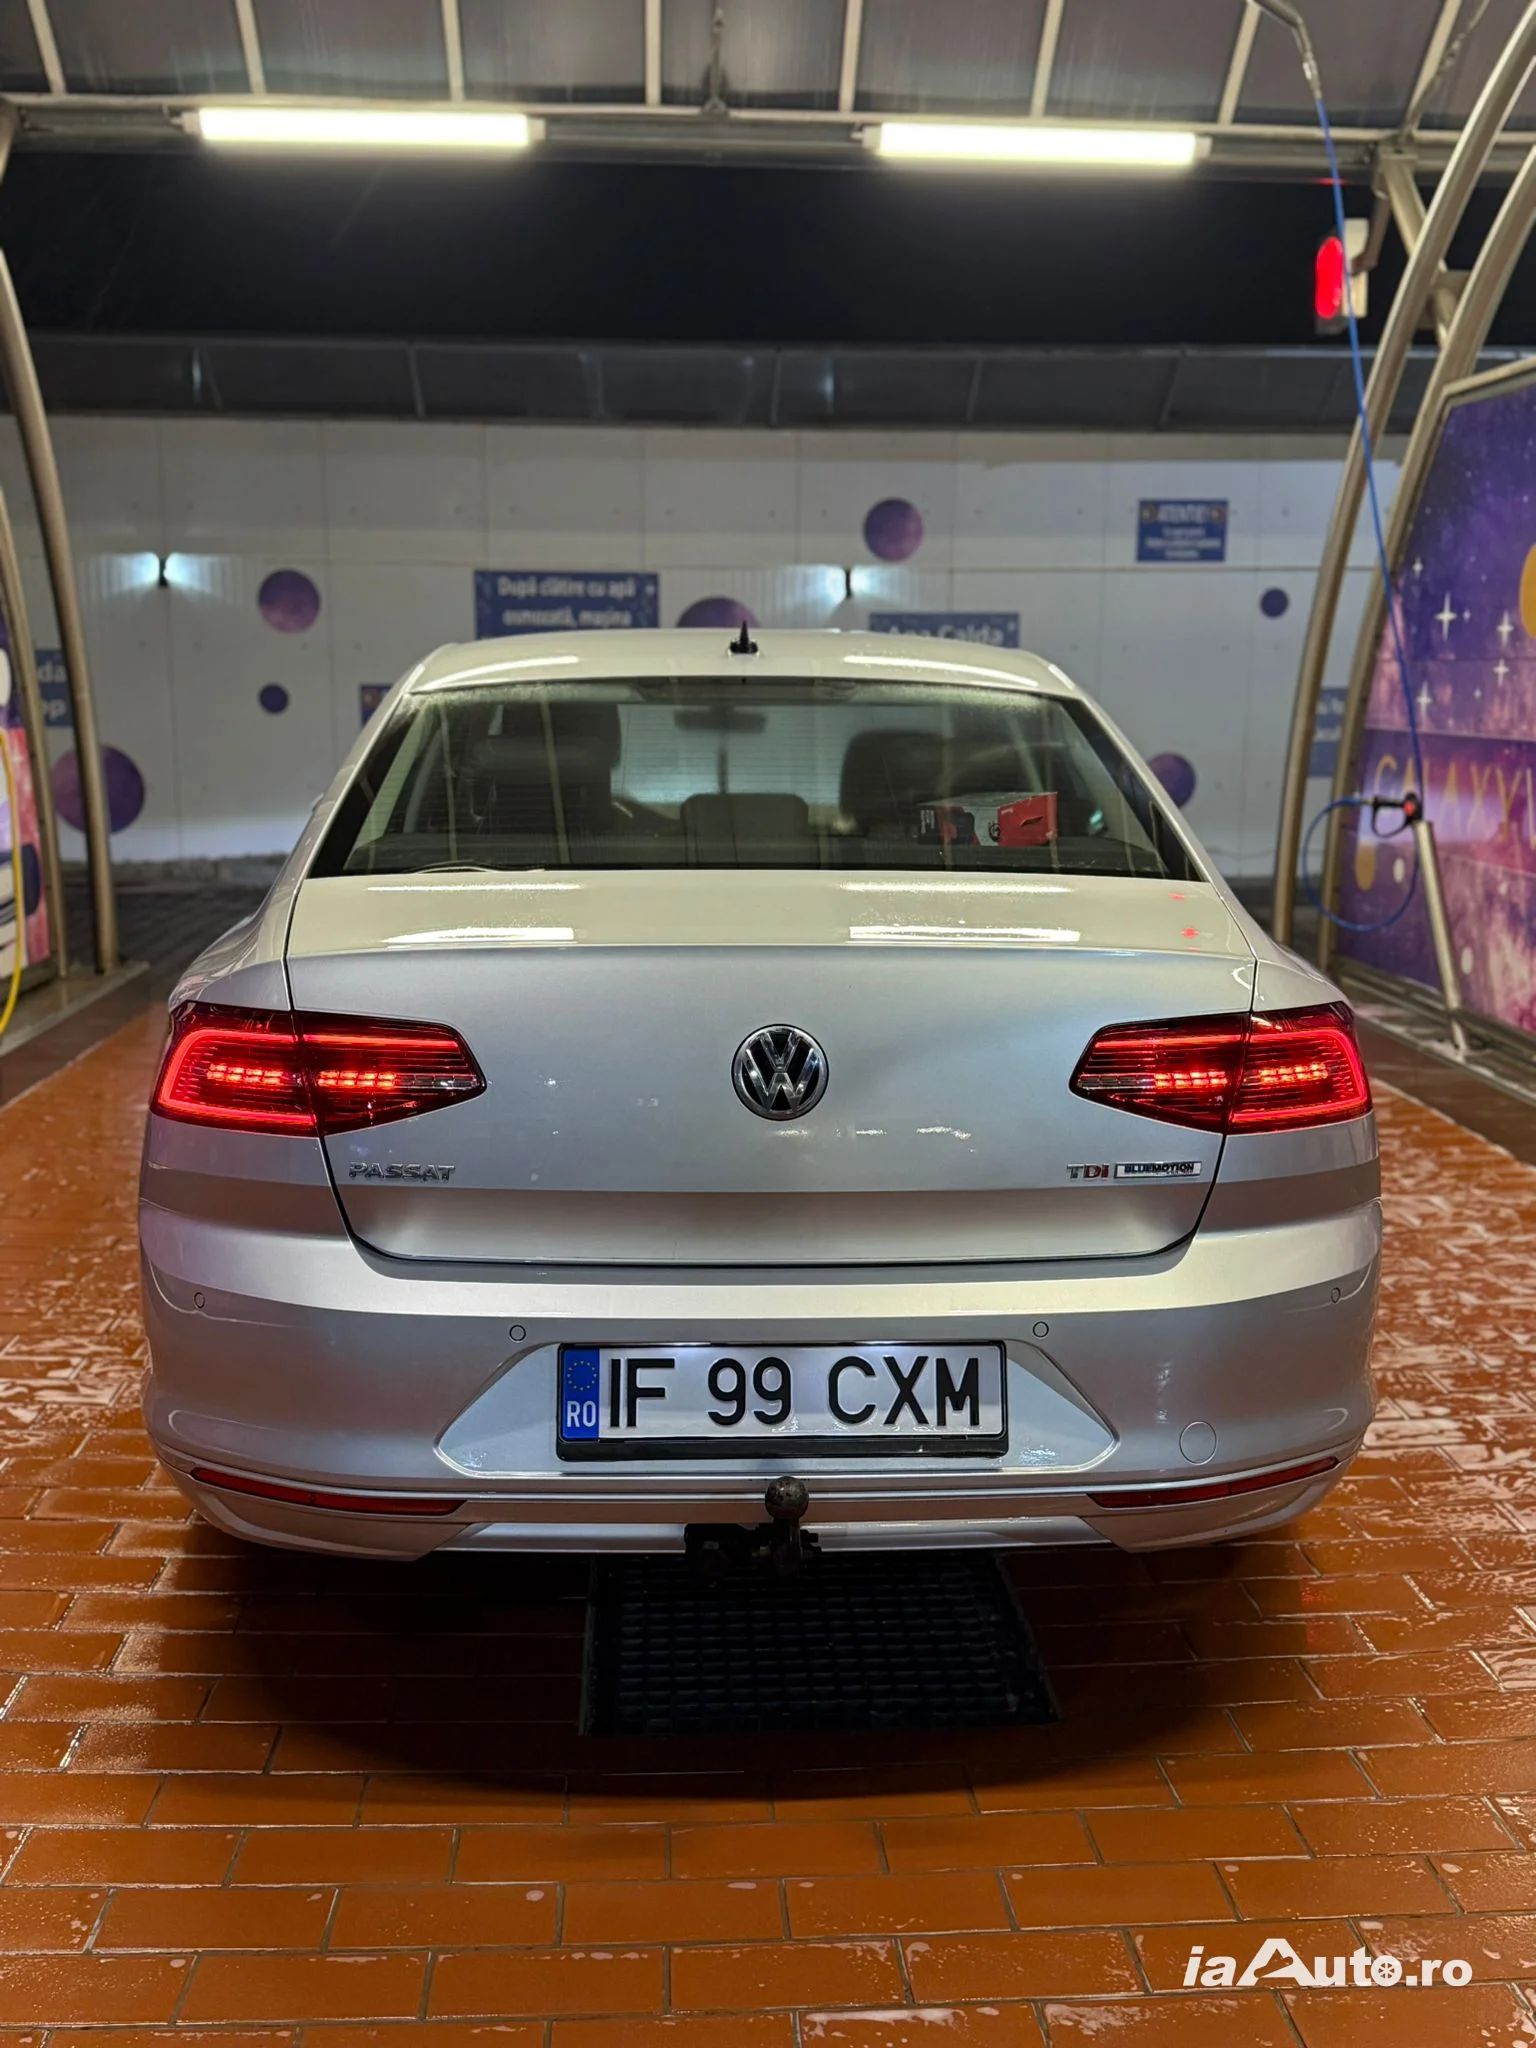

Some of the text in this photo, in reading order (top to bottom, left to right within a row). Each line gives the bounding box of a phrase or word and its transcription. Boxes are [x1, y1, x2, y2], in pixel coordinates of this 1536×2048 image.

[587, 581, 605, 597] cu
[349, 1161, 456, 1182] PASSAT
[609, 1355, 980, 1428] IF 99 CXM
[566, 1400, 597, 1428] RO
